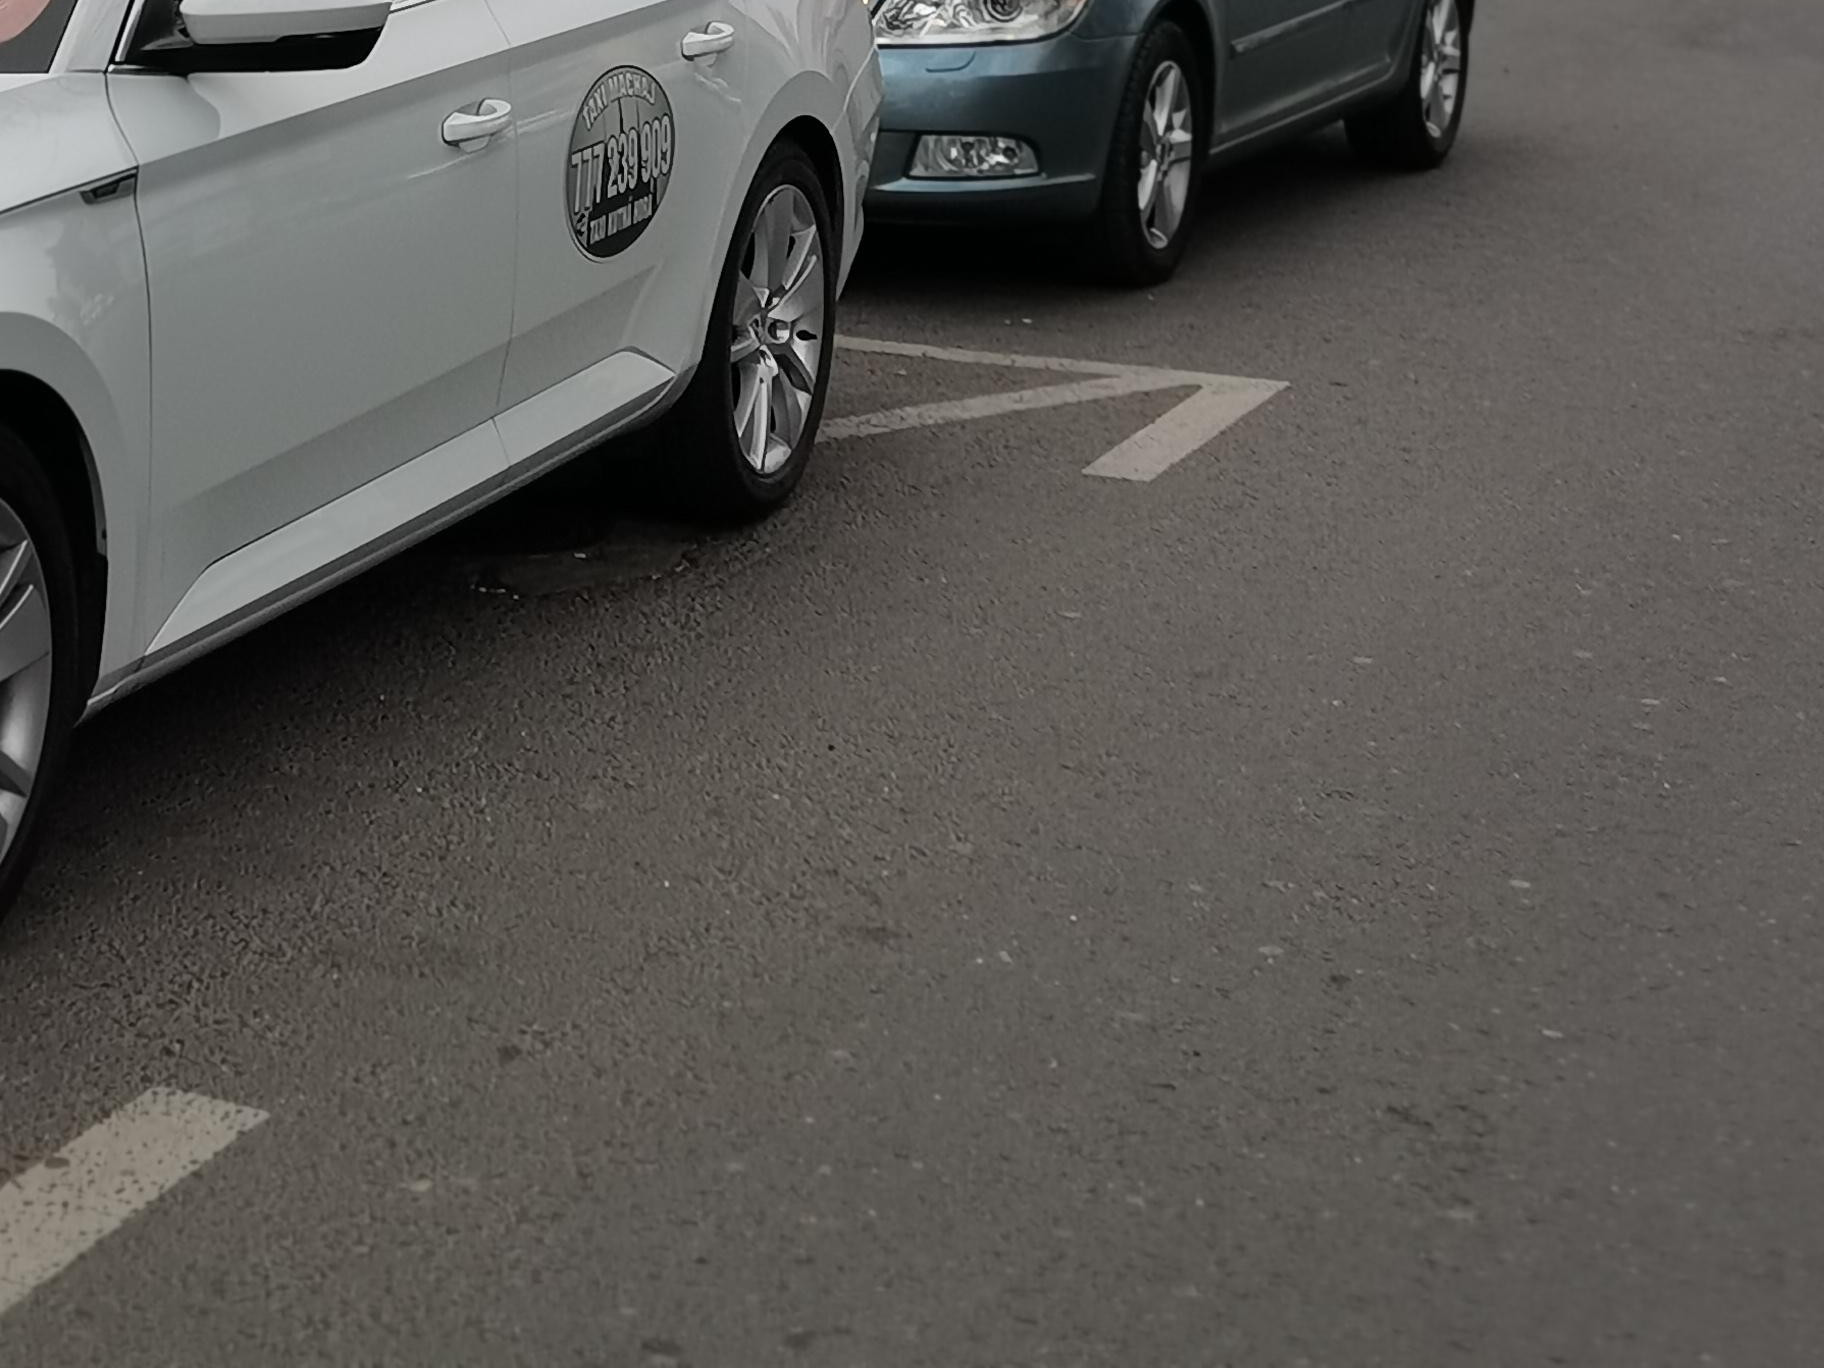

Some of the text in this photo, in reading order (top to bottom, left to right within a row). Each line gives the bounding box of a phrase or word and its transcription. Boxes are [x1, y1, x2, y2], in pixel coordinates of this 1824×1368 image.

[582, 84, 608, 131] TAXI
[571, 113, 672, 214] 777 239 909
